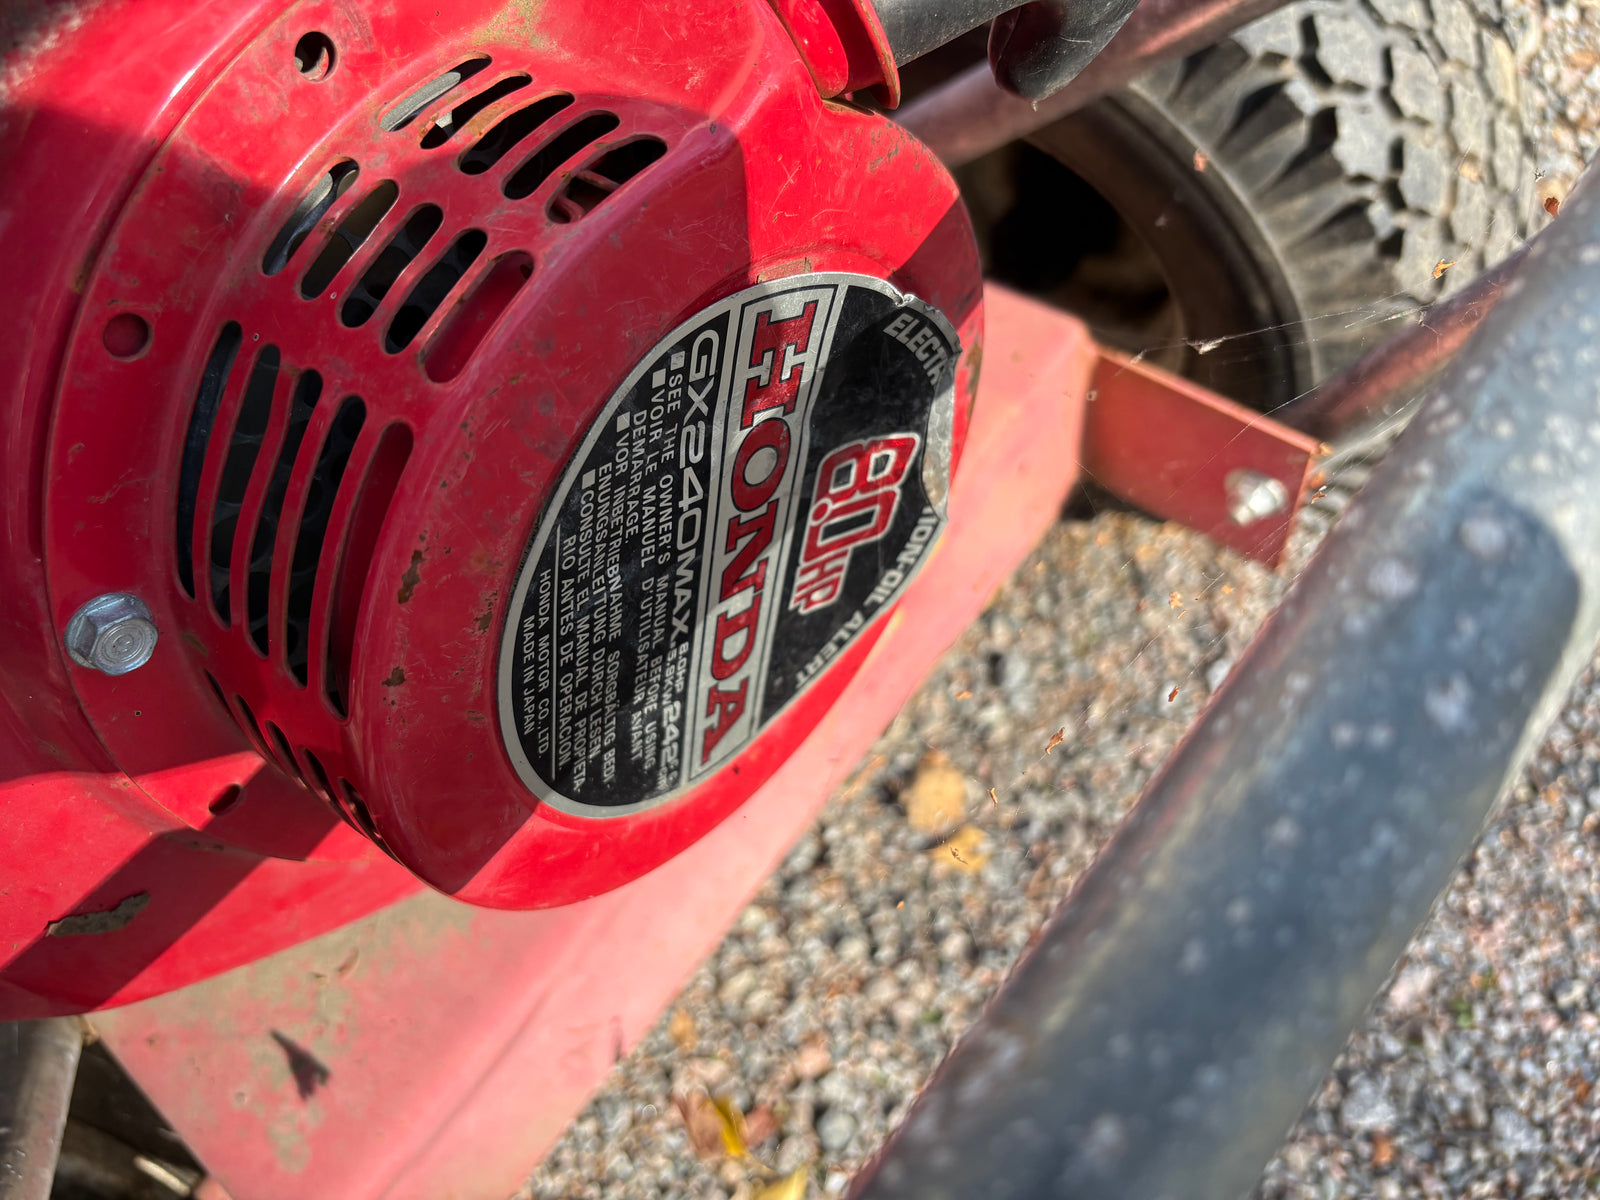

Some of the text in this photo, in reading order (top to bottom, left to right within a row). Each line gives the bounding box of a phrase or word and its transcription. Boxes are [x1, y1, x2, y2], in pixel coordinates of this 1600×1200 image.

[666, 373, 683, 414] SEE
[615, 432, 629, 476] VOR
[625, 410, 647, 543] DEMARRAGE.
[660, 423, 678, 463] THE
[606, 484, 626, 642] INBETRIEBNAHME
[657, 474, 673, 564] OWNER'S
[700, 302, 817, 763] HONDA
[538, 568, 551, 629] HONDA
[587, 462, 612, 763] ENUNGSANLEITUNG DURCH LESEN.
[631, 388, 665, 760] VOIR LE MANUEL D'UTILISATEUR AVANT
[651, 574, 670, 649] MANUAL
[523, 614, 535, 735] MADE IN JAPAN
[537, 633, 550, 692] MOTOR
[558, 534, 577, 770] RIO ANTES DE OPERACION.
[573, 489, 593, 793] CONSULTE EL MANUAL DE PROPIETA-
[644, 656, 662, 715] BEFORE
[796, 611, 864, 692] ALERT
